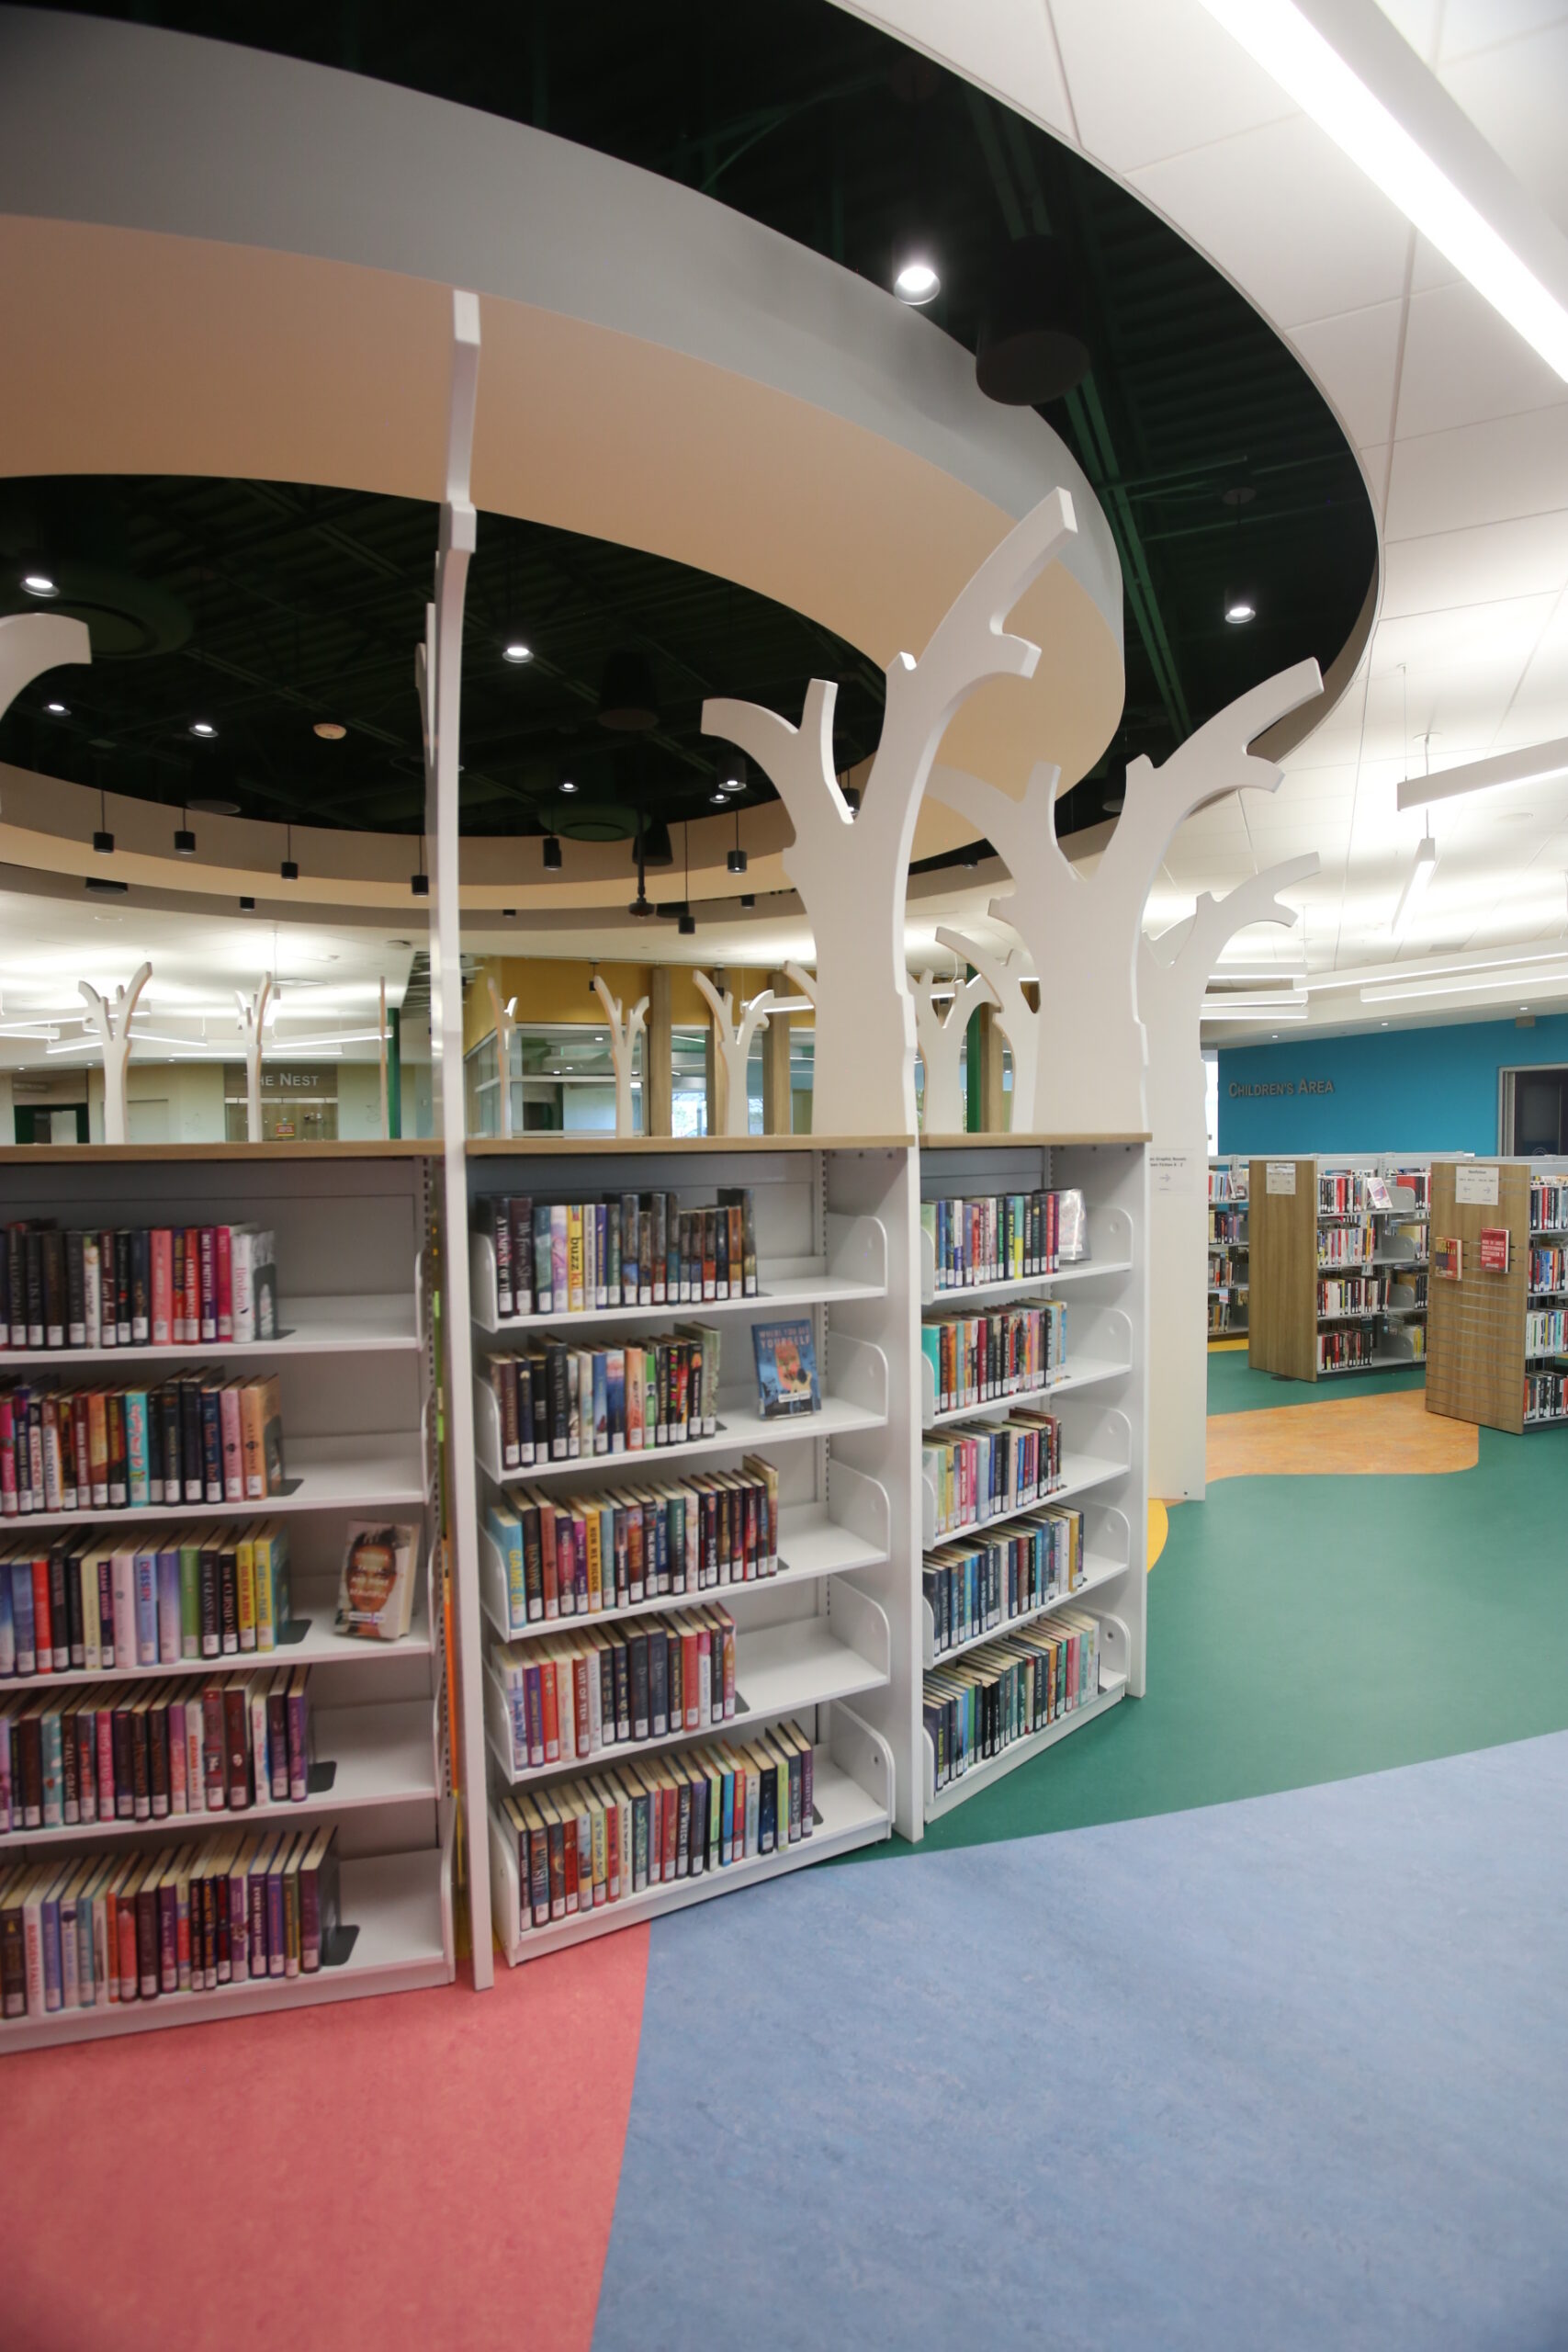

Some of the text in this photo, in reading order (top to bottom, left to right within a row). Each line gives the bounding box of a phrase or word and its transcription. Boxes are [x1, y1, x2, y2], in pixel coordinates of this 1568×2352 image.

[570, 1237, 581, 1271] buzz
[235, 1267, 247, 1309] Broken
[140, 1562, 150, 1601] DESSEN
[509, 1549, 523, 1590] GAME
[578, 1668, 586, 1685] LIST
[580, 1687, 586, 1701] OF
[64, 1744, 74, 1800] FALL GRAC
